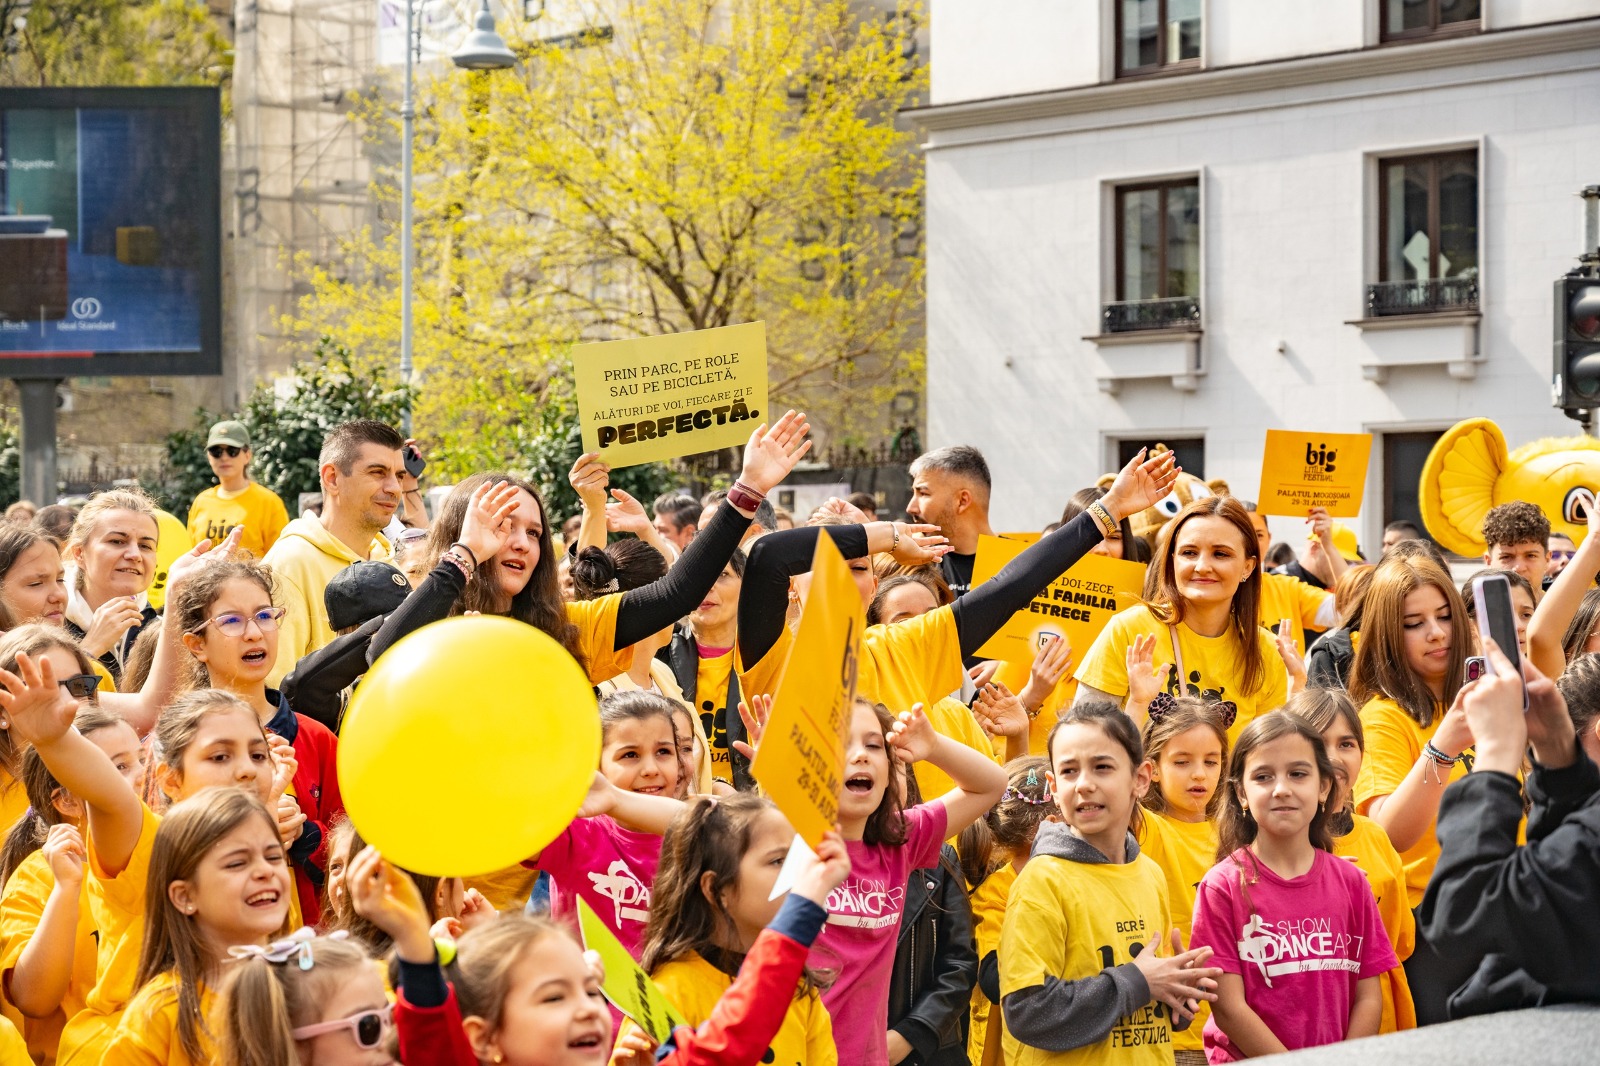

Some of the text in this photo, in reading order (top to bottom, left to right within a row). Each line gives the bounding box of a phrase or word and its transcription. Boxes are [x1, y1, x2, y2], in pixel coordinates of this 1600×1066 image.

[57, 321, 116, 331] Ideal Standard
[604, 352, 740, 382] PRIN PARC, PE ROLE
[610, 367, 737, 398] SAU PE BICICLETĂ,
[593, 386, 753, 421] ALĂTURI DE VOI, FIECARE ZI E
[597, 397, 760, 449] PERFECTĂ.
[1305, 442, 1337, 472] big
[1303, 474, 1334, 482] FESTIVAL
[1277, 489, 1311, 498] PALATUL
[1062, 577, 1116, 597] DOI-ZECE,
[1053, 588, 1117, 611] FAMILIA
[1116, 921, 1138, 933] BCR
[1276, 917, 1331, 936] SHOW
